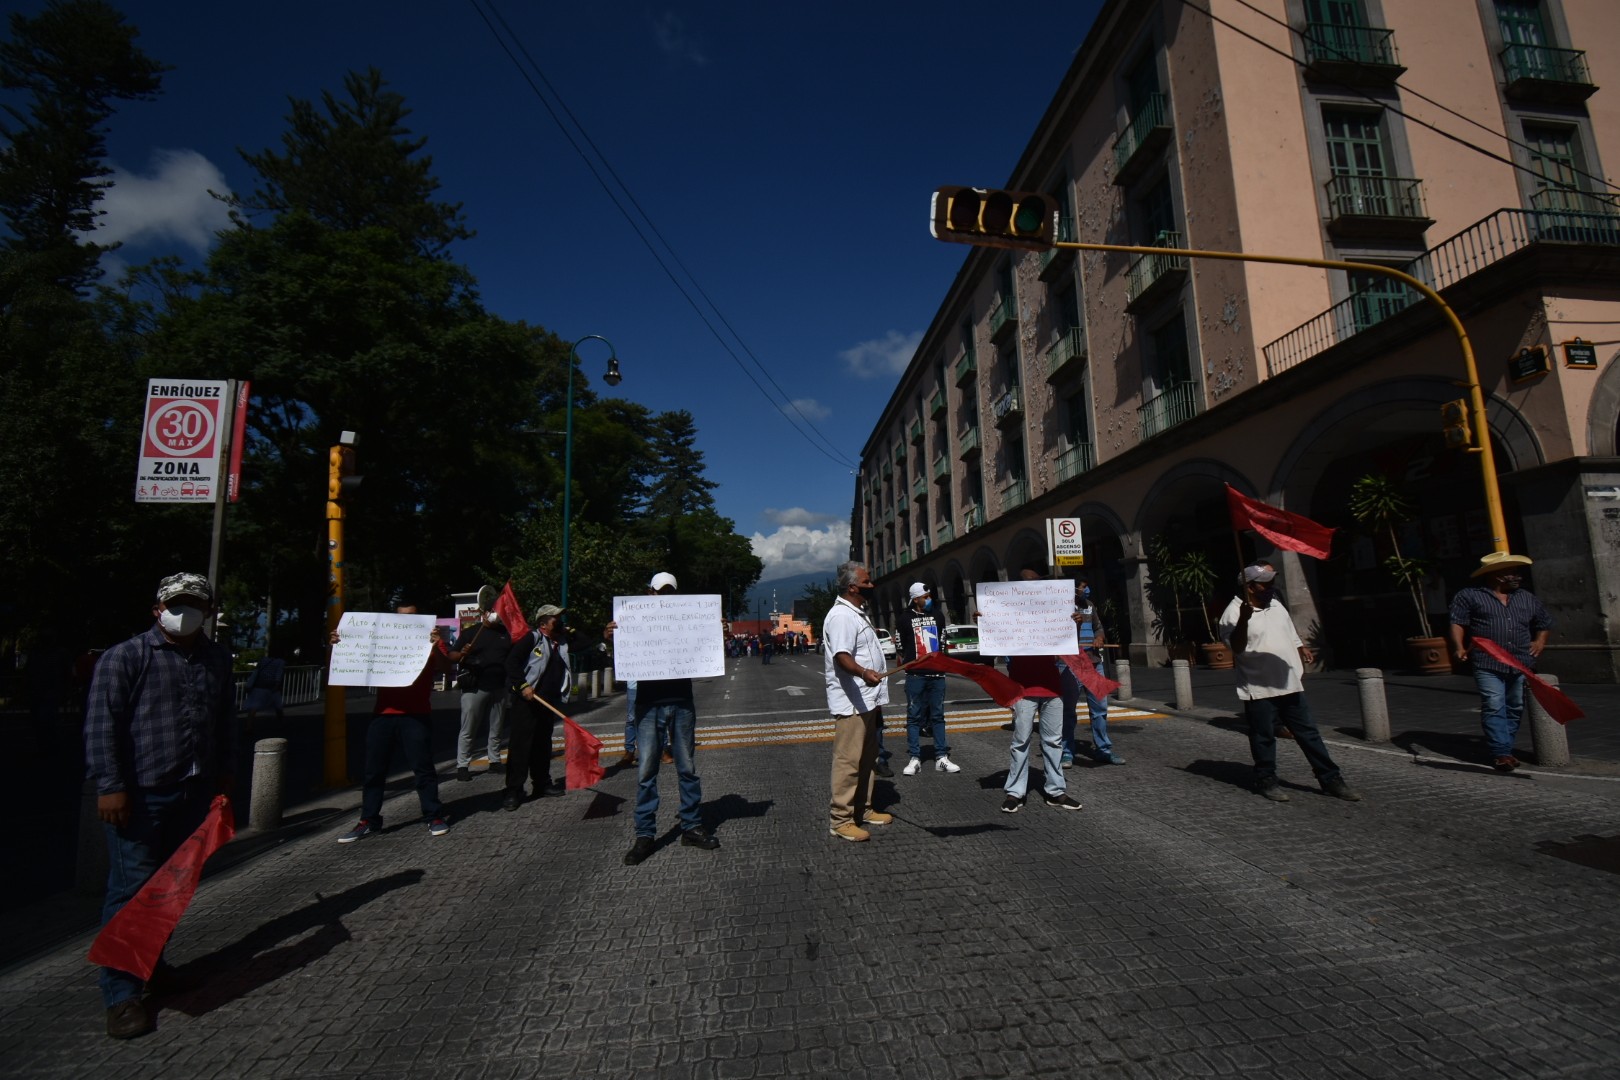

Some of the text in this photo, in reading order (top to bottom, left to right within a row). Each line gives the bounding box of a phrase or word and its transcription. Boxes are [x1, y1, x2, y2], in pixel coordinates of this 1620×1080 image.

[150, 384, 220, 398] ENRÍQUEZ
[162, 409, 202, 438] 30
[168, 438, 194, 446] MÁX
[153, 462, 200, 474] ZONA
[348, 616, 368, 627] ALTO
[620, 625, 642, 634] ALTO
